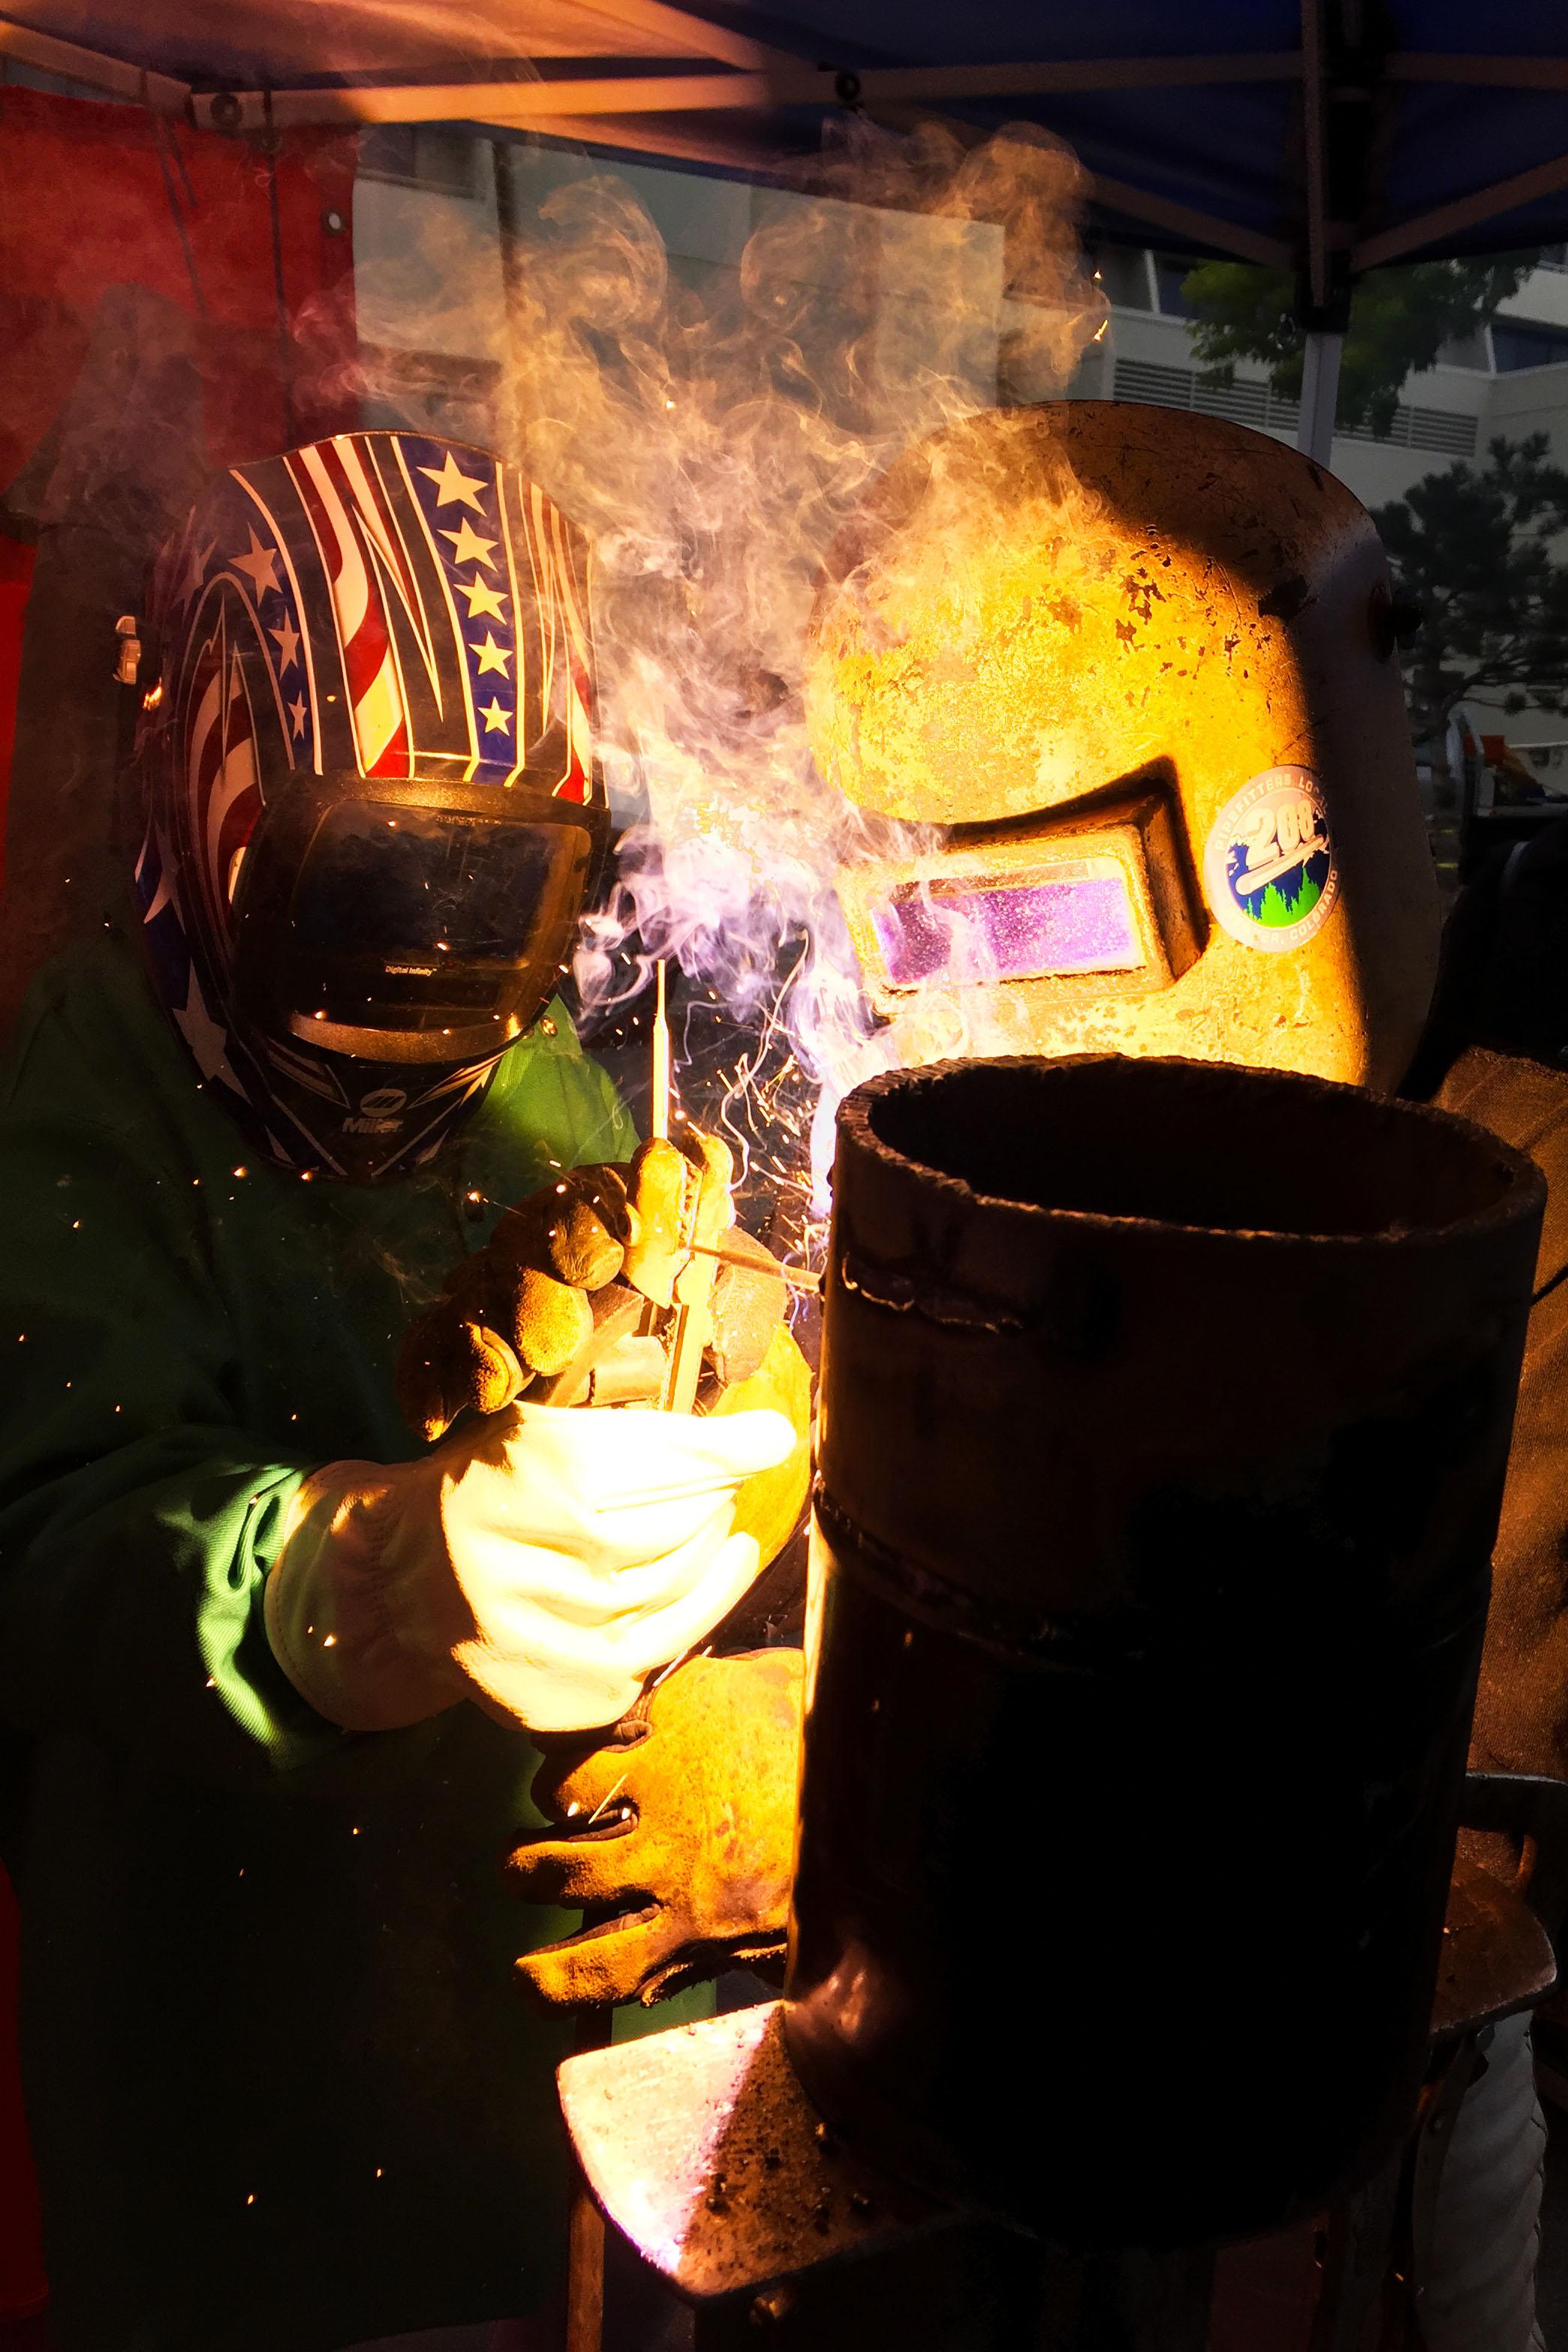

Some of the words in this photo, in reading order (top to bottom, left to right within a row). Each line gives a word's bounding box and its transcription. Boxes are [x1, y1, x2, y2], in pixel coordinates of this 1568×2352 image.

[1213, 773, 1293, 852] PIPEFITTERS
[1245, 799, 1315, 869] 208
[1290, 869, 1338, 939] COLORADO
[384, 965, 409, 975] Digital
[342, 1117, 405, 1134] Miller
